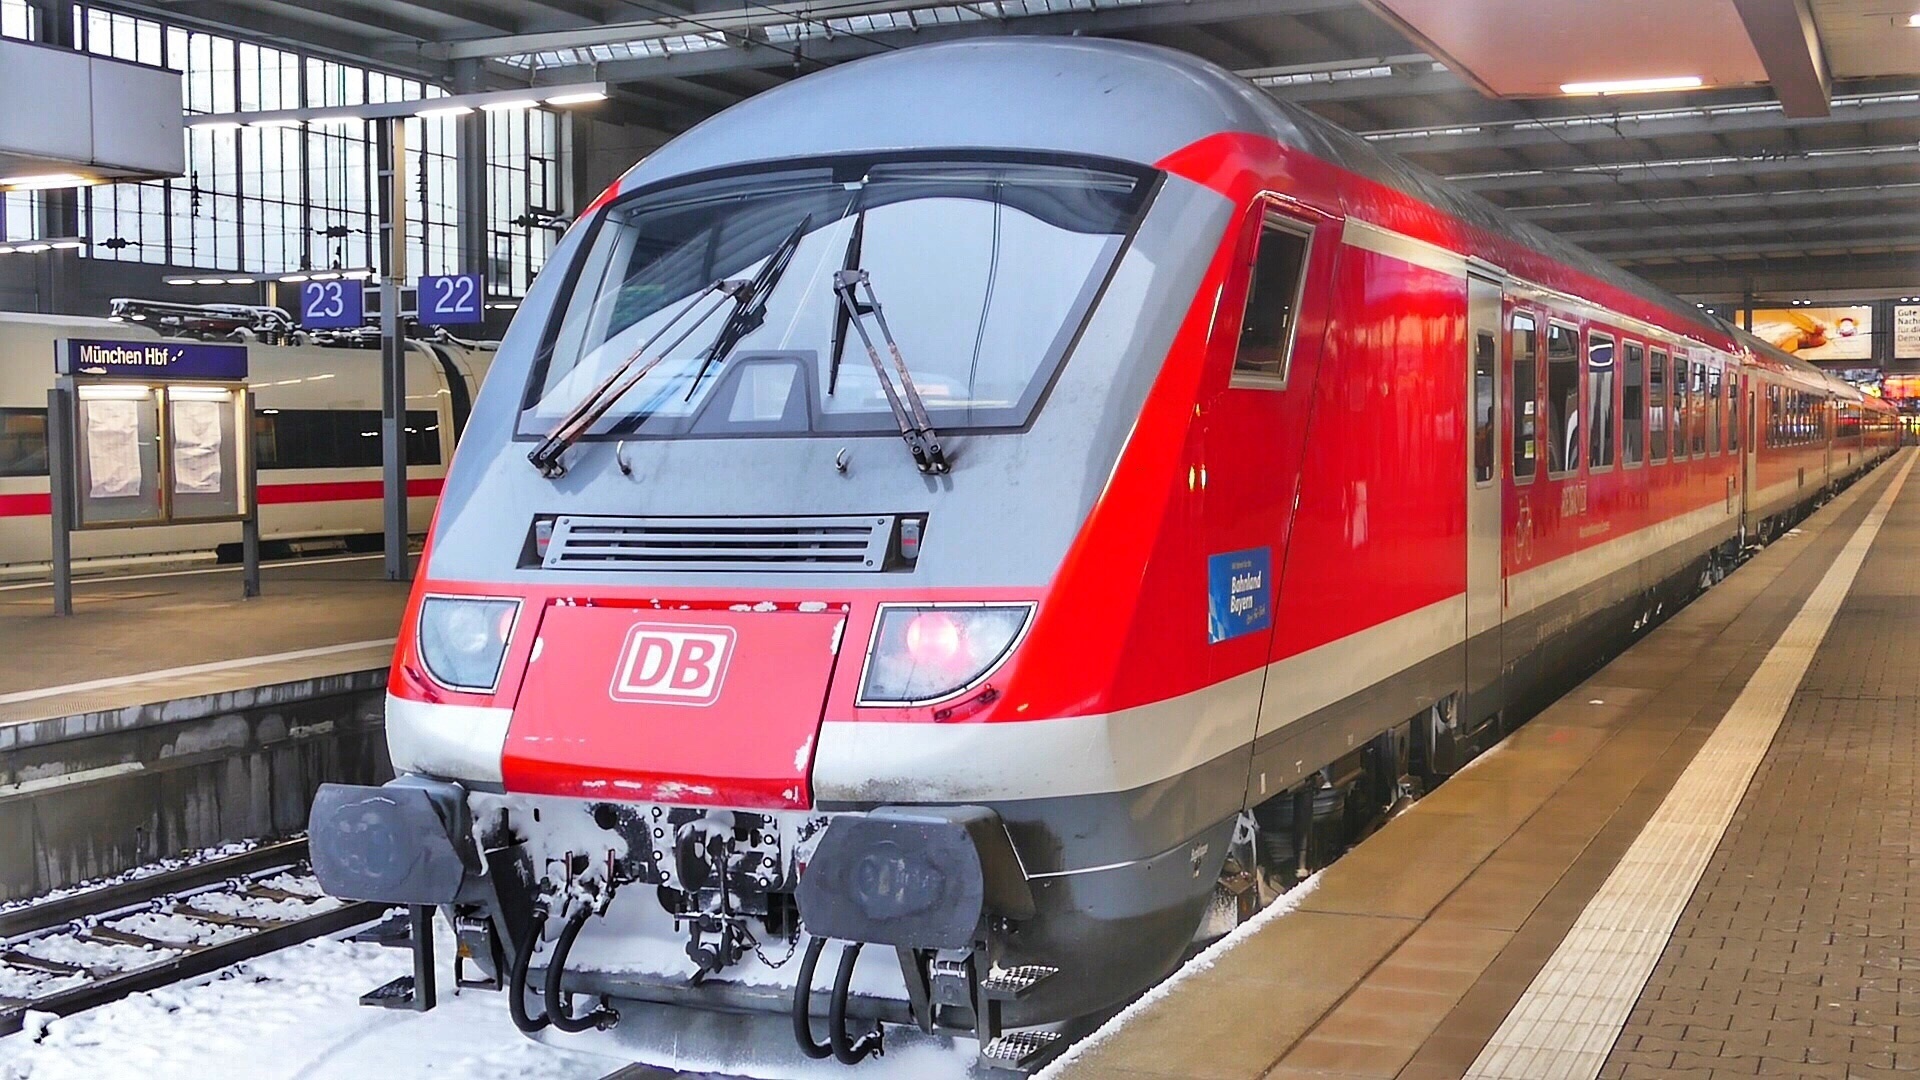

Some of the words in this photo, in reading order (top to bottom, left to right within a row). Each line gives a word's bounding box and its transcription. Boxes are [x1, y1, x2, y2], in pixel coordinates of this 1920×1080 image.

[306, 281, 344, 318] 23
[435, 276, 474, 313] 22
[1898, 309, 1918, 317] Gute
[80, 345, 142, 365] München
[144, 347, 169, 366] Hbf
[1230, 595, 1253, 616] Bayern
[625, 636, 717, 691] DB
